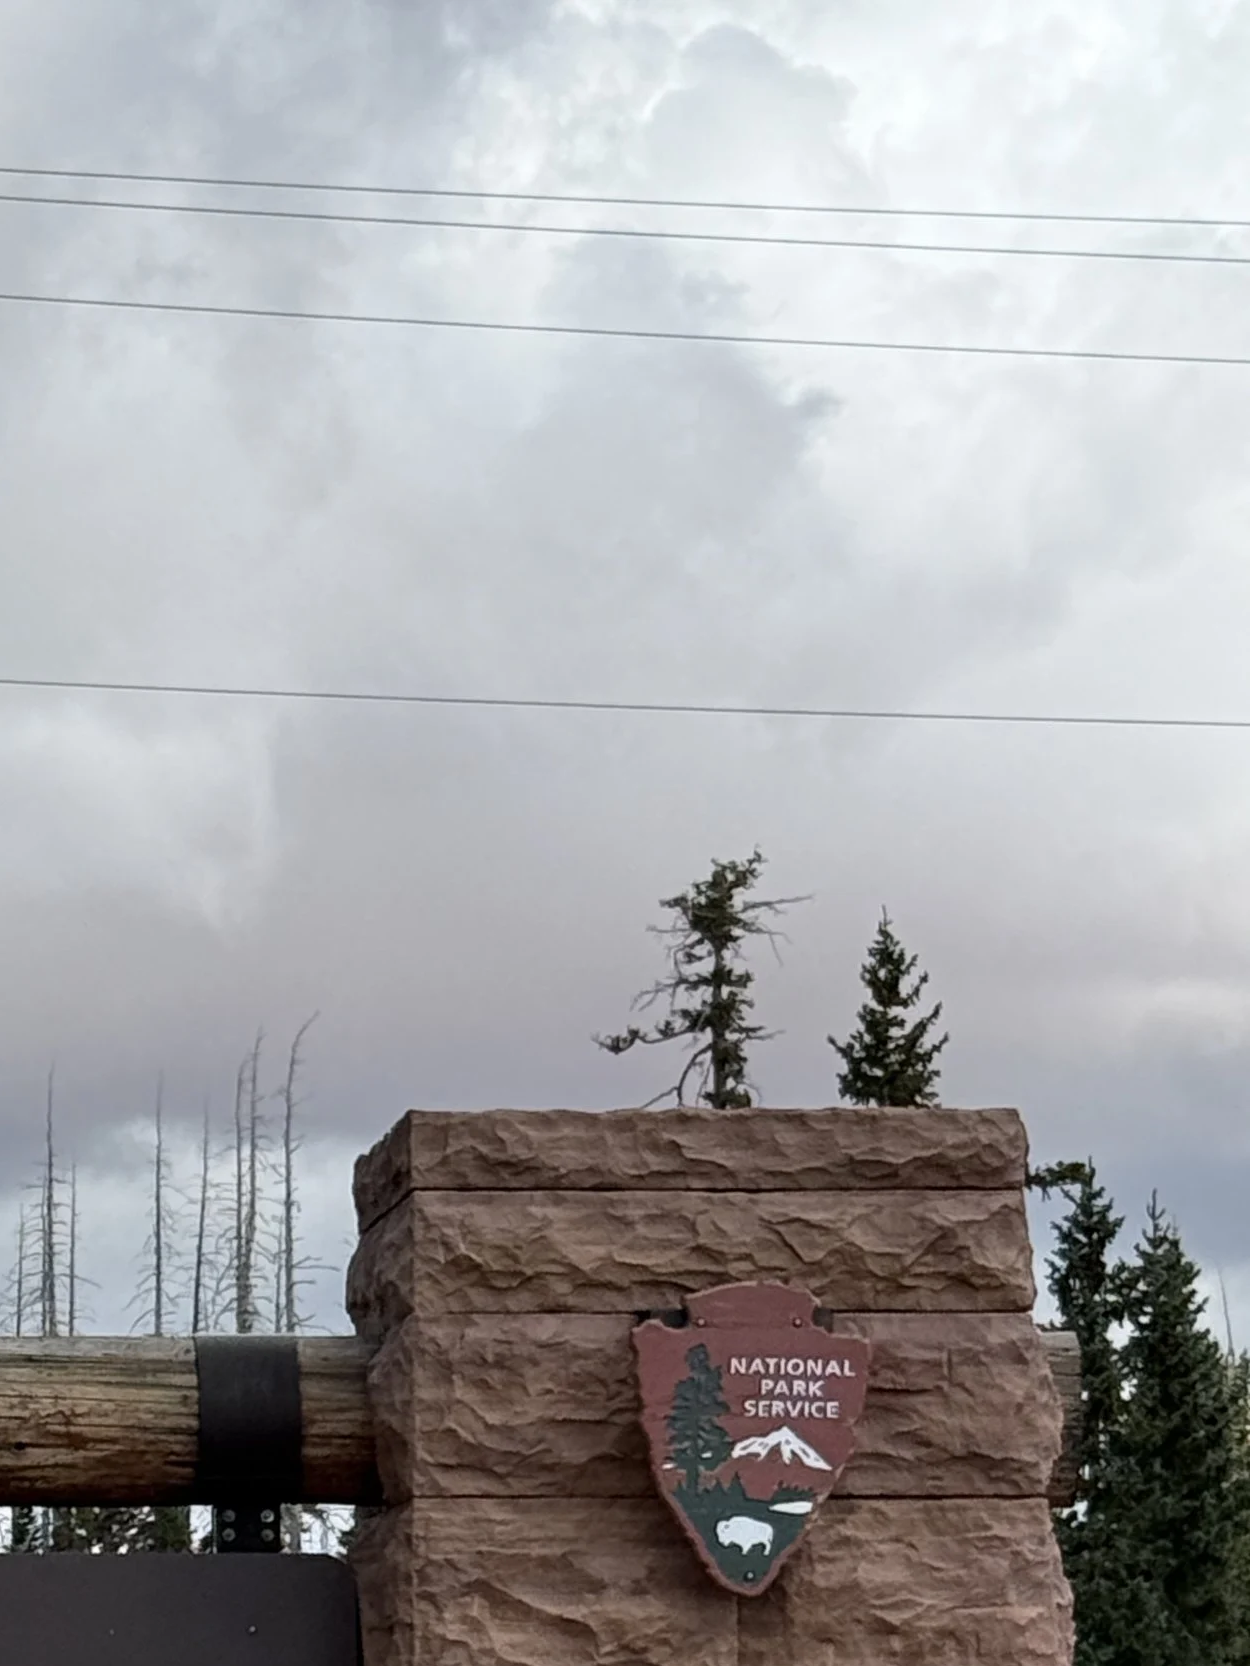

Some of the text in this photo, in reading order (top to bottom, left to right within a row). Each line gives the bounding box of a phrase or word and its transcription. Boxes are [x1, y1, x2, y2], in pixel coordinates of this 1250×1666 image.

[730, 1357, 856, 1377] NATIONAL
[760, 1379, 825, 1398] PARK
[743, 1399, 840, 1418] SERVICE
